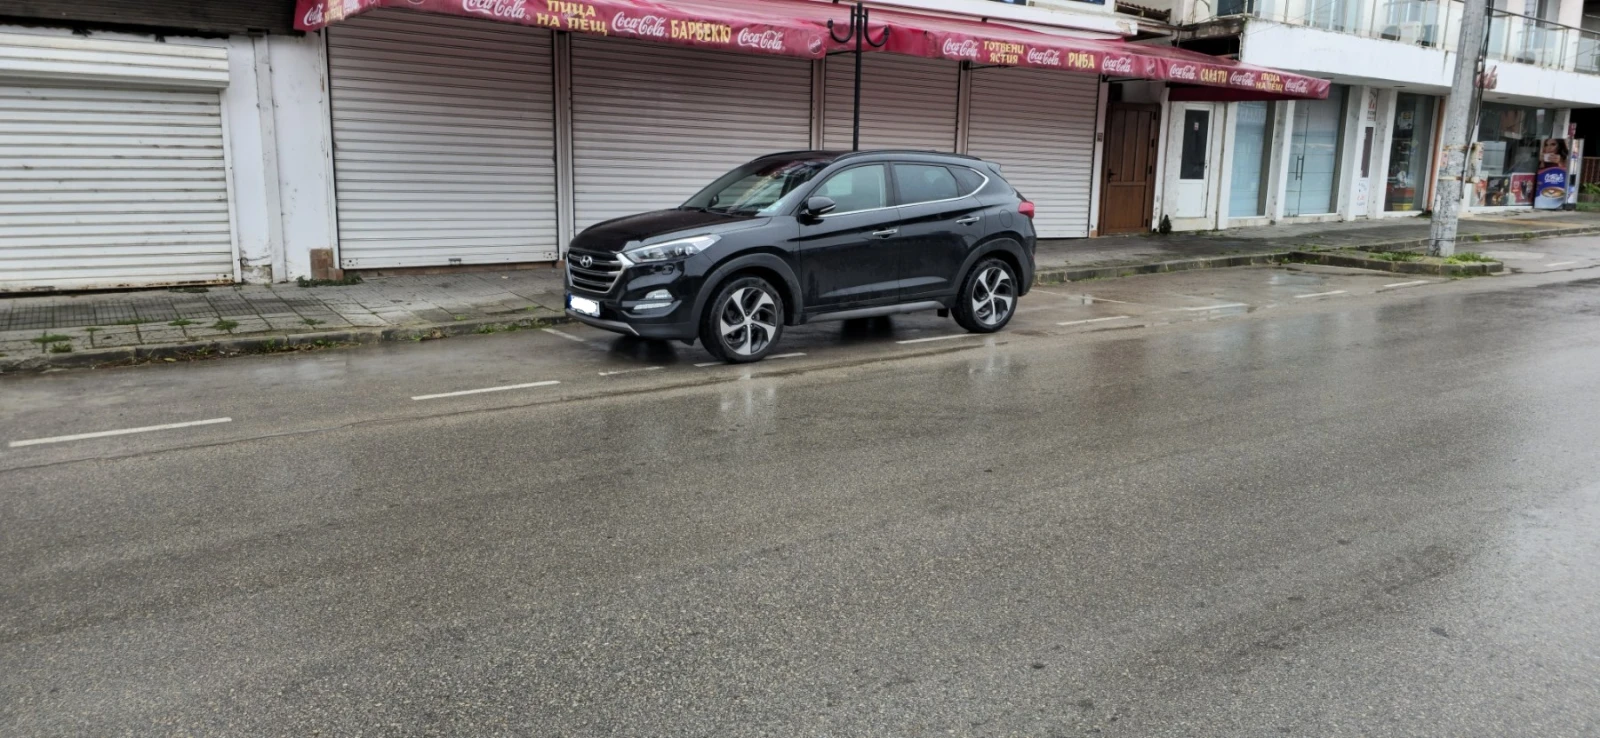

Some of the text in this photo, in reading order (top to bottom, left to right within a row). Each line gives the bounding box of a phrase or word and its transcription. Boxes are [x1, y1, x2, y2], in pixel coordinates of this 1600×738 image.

[547, 0, 596, 19] ПИЦА
[536, 13, 607, 37] НА ПЕЩ
[611, 11, 666, 37] Coca-Cola
[670, 19, 732, 43] БАРБЕКЮ
[737, 27, 784, 50] Coca-Cola
[942, 38, 979, 57] Coca-Cola
[1027, 48, 1060, 66] Coca-Cola
[1068, 52, 1095, 69] РИБА
